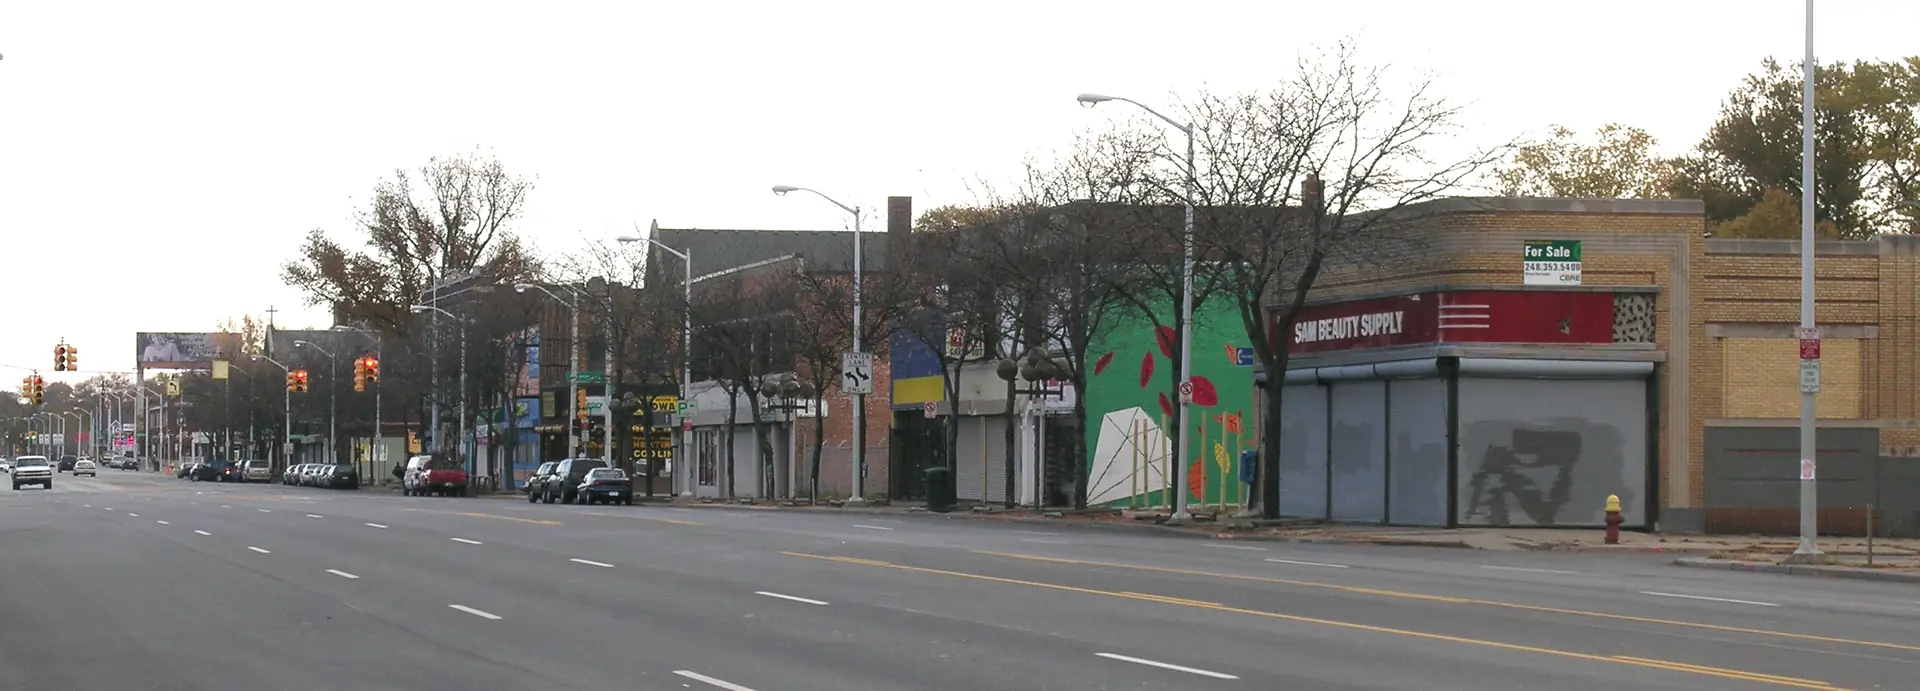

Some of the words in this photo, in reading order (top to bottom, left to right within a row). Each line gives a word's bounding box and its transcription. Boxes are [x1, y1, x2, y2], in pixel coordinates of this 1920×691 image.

[1525, 245, 1543, 257] For
[1546, 245, 1571, 257] Sale
[1295, 321, 1317, 344] SAM
[1318, 315, 1360, 341] BEAUTY
[1360, 311, 1404, 336] SUPPLY
